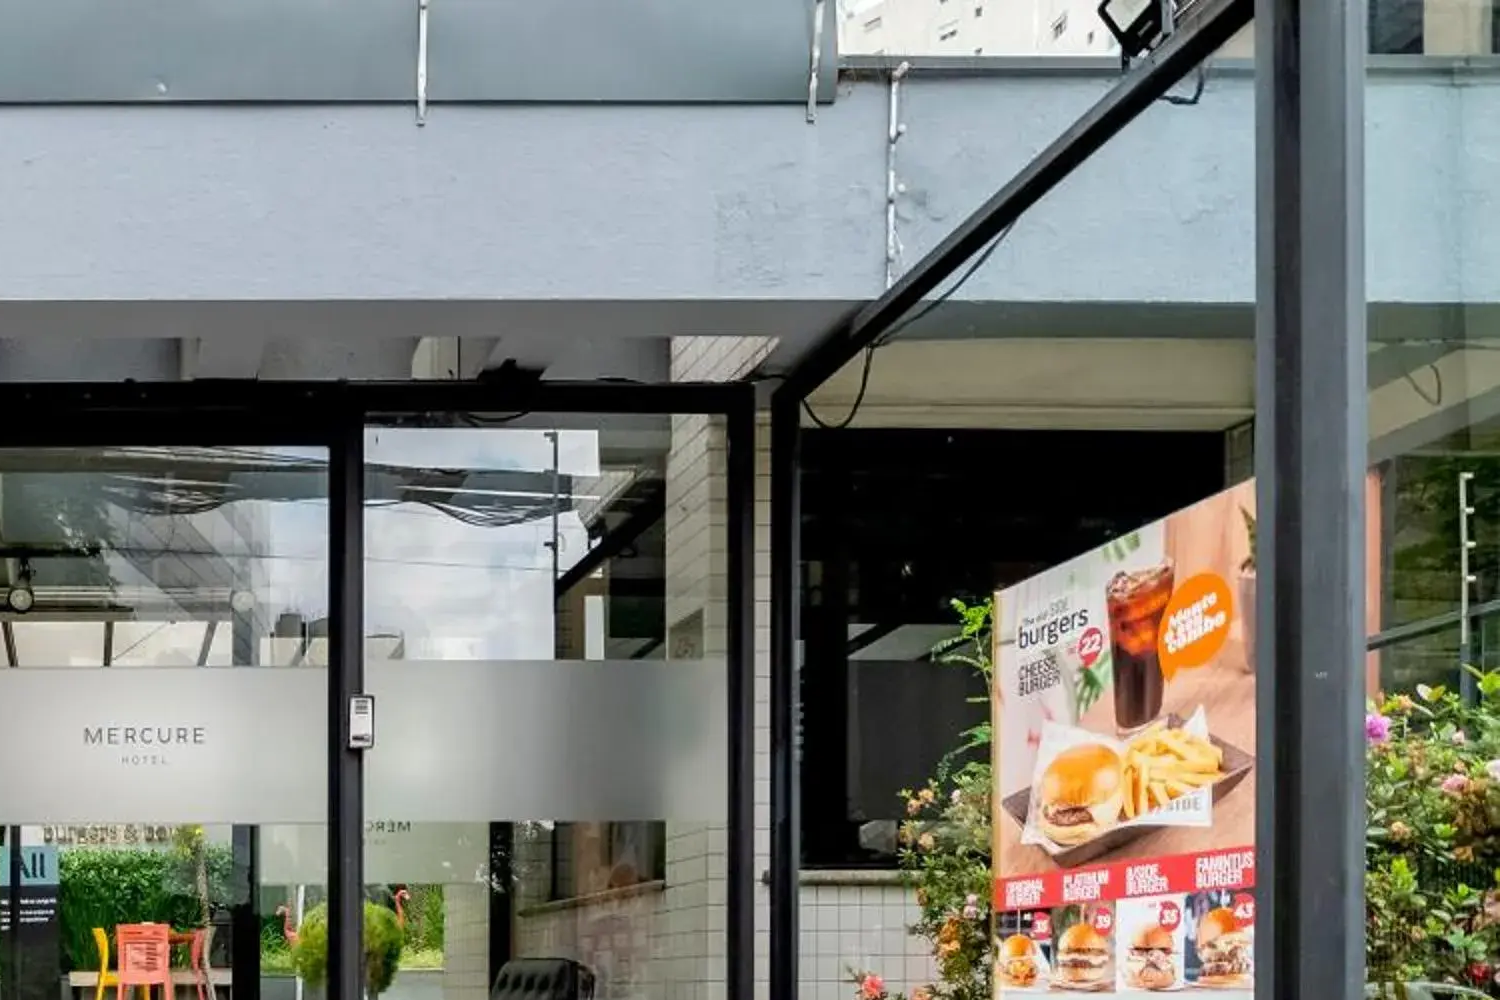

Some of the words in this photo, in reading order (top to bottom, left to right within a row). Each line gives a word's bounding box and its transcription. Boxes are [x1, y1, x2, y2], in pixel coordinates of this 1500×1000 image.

[1019, 608, 1089, 650] burgers
[1080, 635, 1100, 649] 22
[1018, 669, 1061, 696] BURGER
[83, 727, 206, 745] MERCURE
[120, 755, 167, 765] HOTEL
[1195, 868, 1243, 889] BURGER
